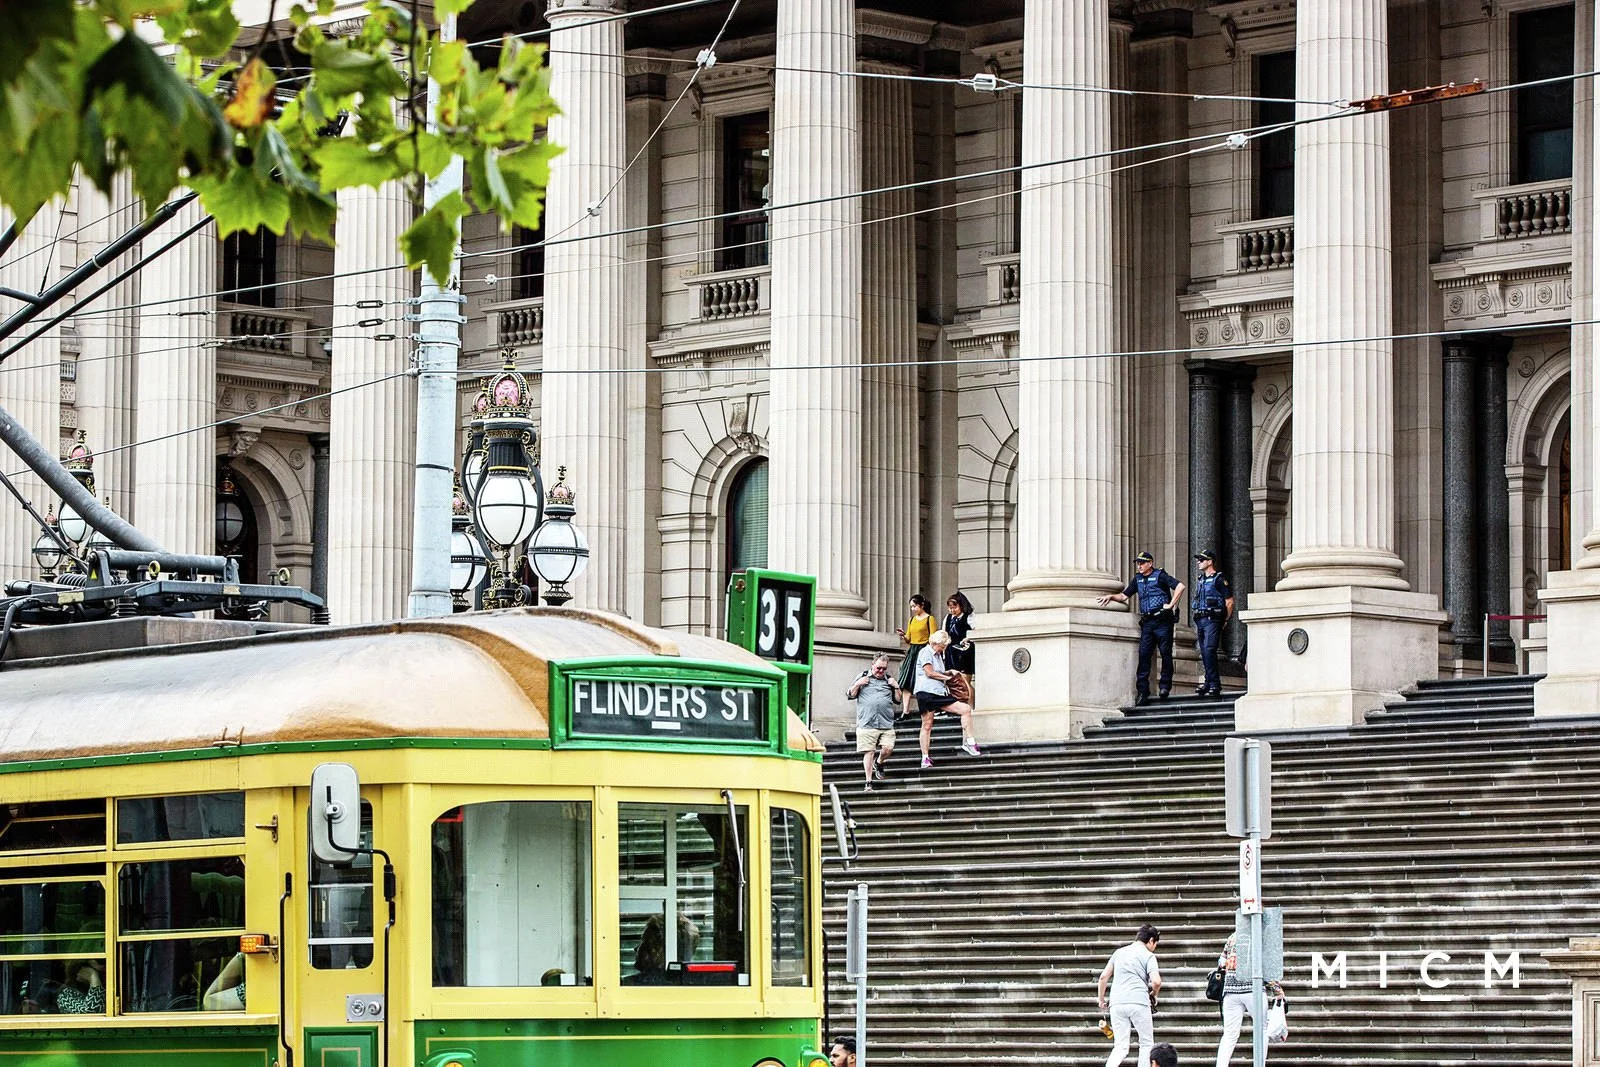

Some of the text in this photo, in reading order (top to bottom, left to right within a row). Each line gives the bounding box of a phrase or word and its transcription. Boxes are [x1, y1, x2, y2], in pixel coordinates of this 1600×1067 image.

[758, 588, 802, 657] 35
[574, 681, 754, 721] FLINDERS ST
